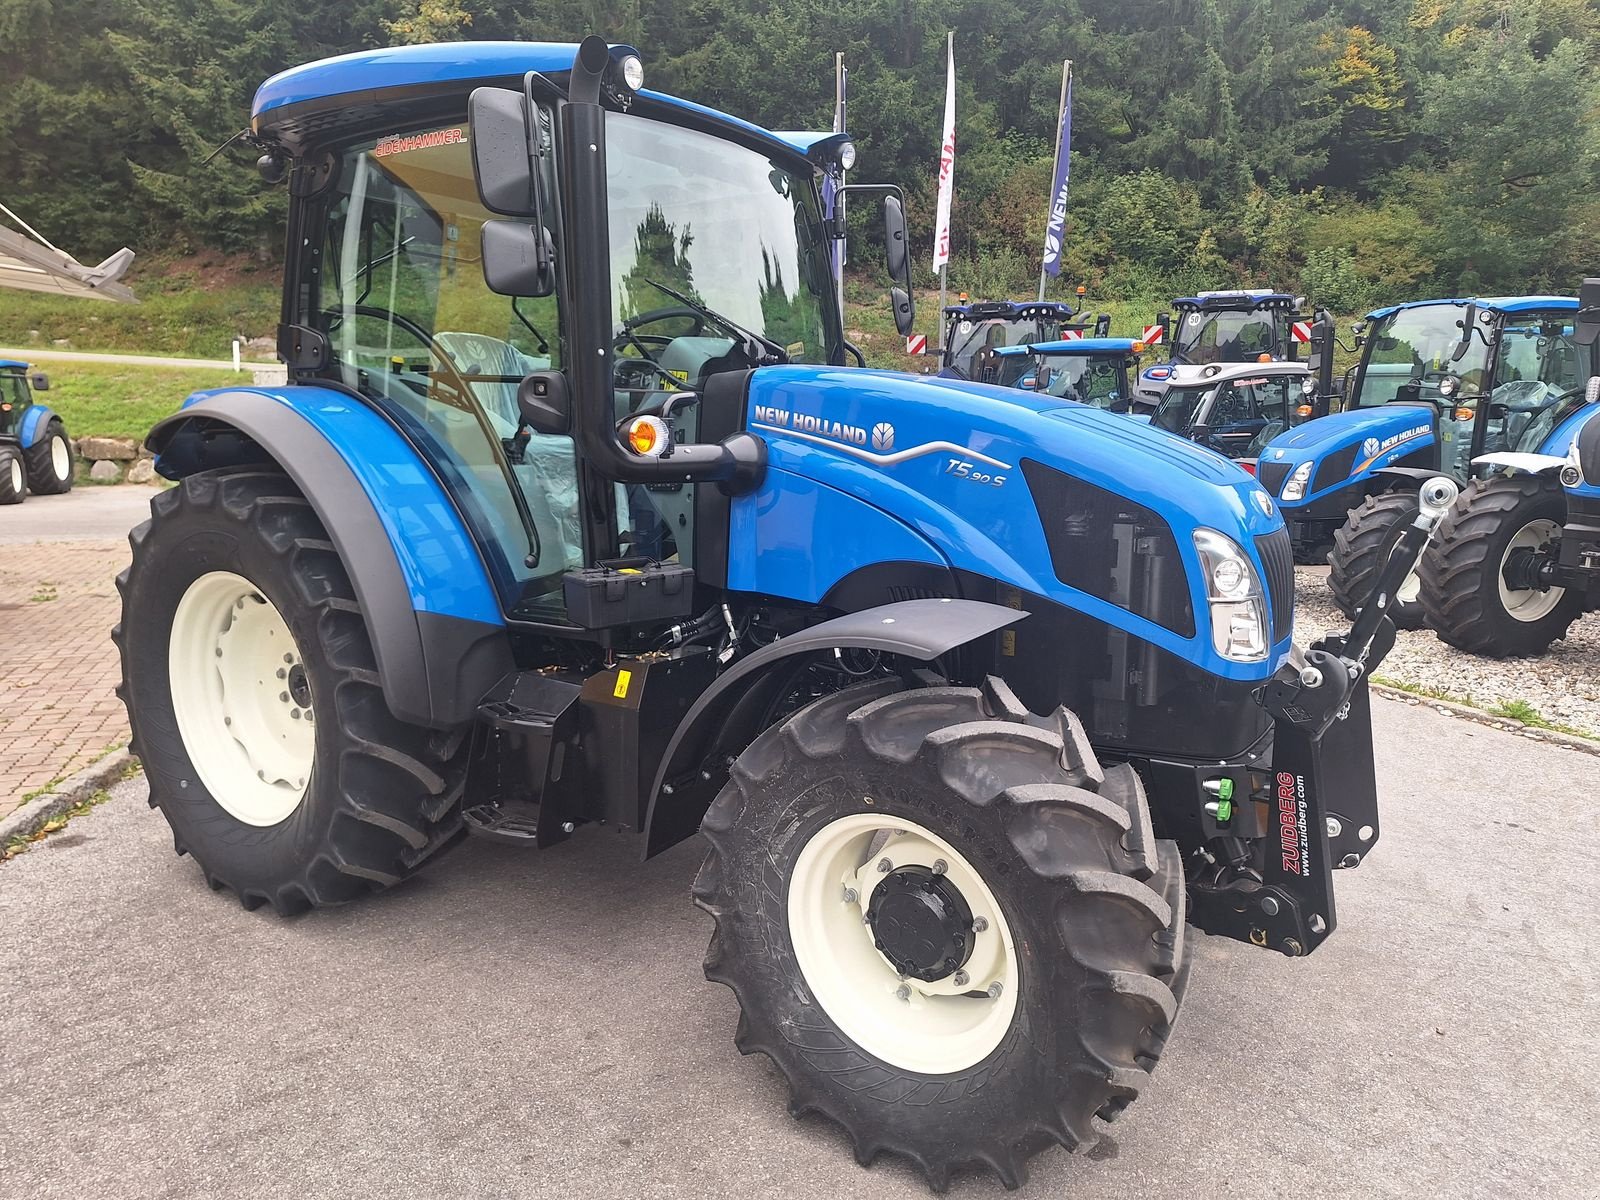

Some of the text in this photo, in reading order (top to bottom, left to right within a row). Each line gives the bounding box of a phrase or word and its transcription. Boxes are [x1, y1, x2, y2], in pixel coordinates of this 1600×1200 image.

[376, 129, 462, 157] EIDENHAMMER
[755, 405, 867, 445] NEW HOLLAND
[1381, 425, 1430, 449] NEW HOLLAND
[1277, 772, 1300, 874] ZUIDBERG
[1297, 775, 1310, 876] www.zuidberg.com
